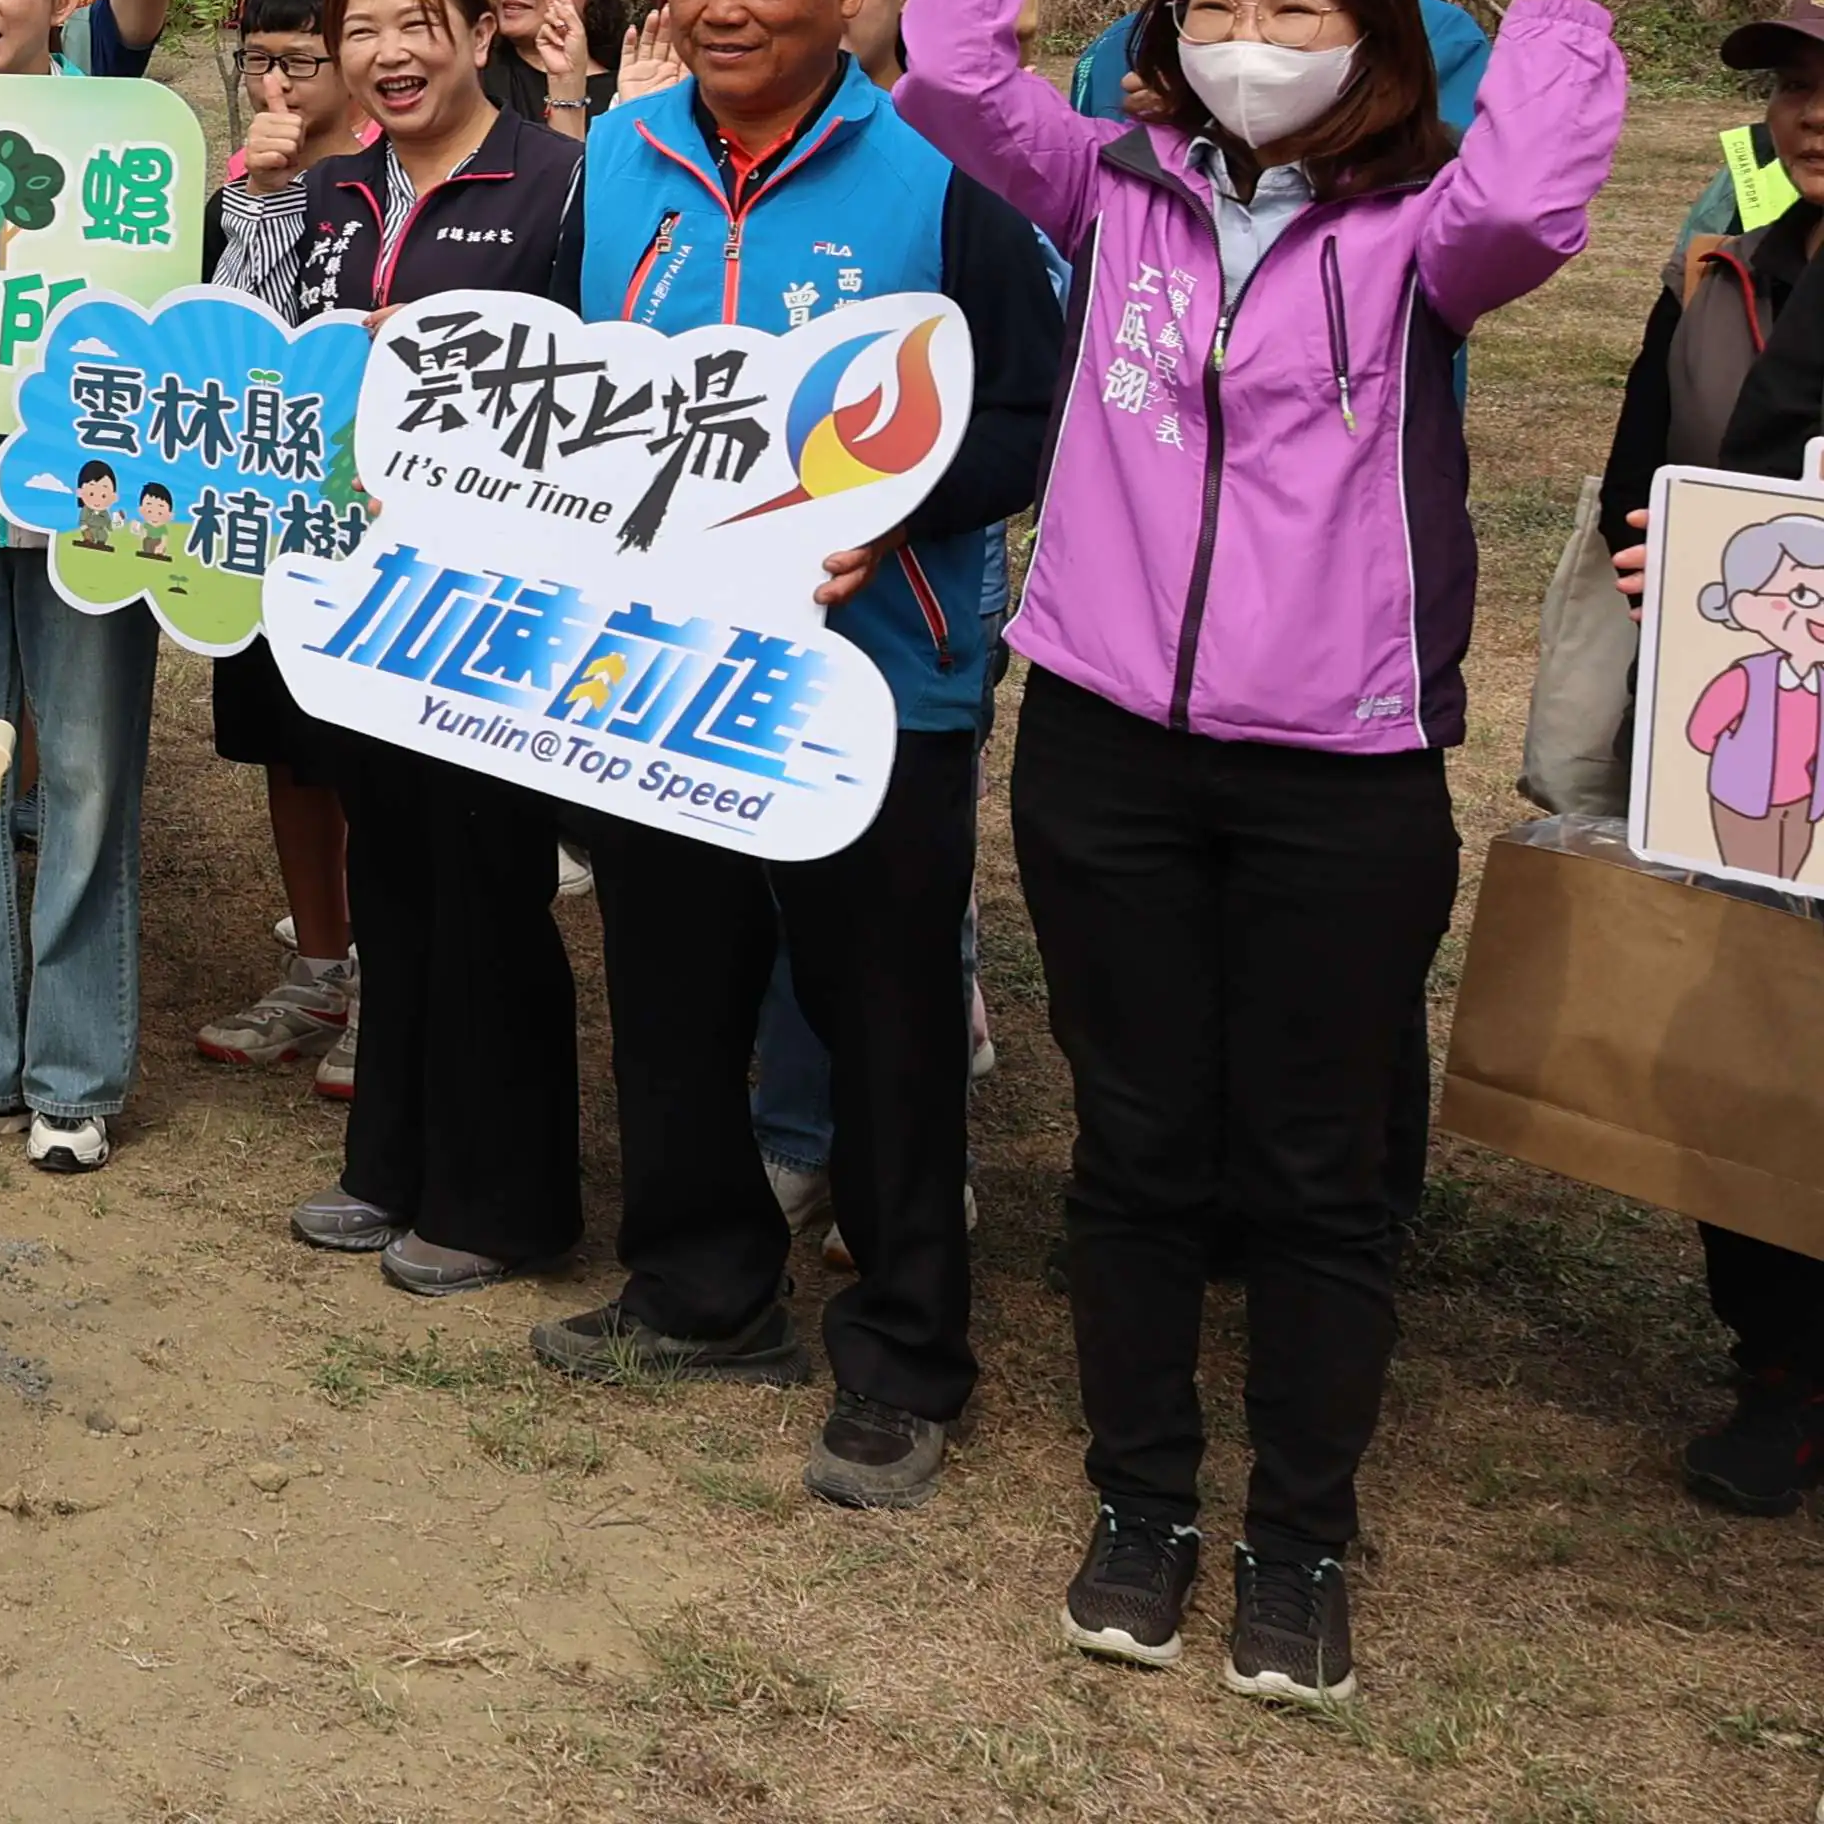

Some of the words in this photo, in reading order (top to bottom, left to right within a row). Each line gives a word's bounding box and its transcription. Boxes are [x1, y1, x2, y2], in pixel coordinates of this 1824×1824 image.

[300, 236, 332, 309] 洪如
[813, 241, 853, 258] FILA
[782, 281, 821, 327] 曾
[73, 365, 327, 481] 雲林縣
[383, 450, 448, 490] It's
[454, 466, 523, 505] Our
[527, 481, 615, 526] Time
[302, 542, 837, 786] 加速前進
[416, 694, 634, 786] Yunlin@Top
[638, 758, 775, 823] Speed
